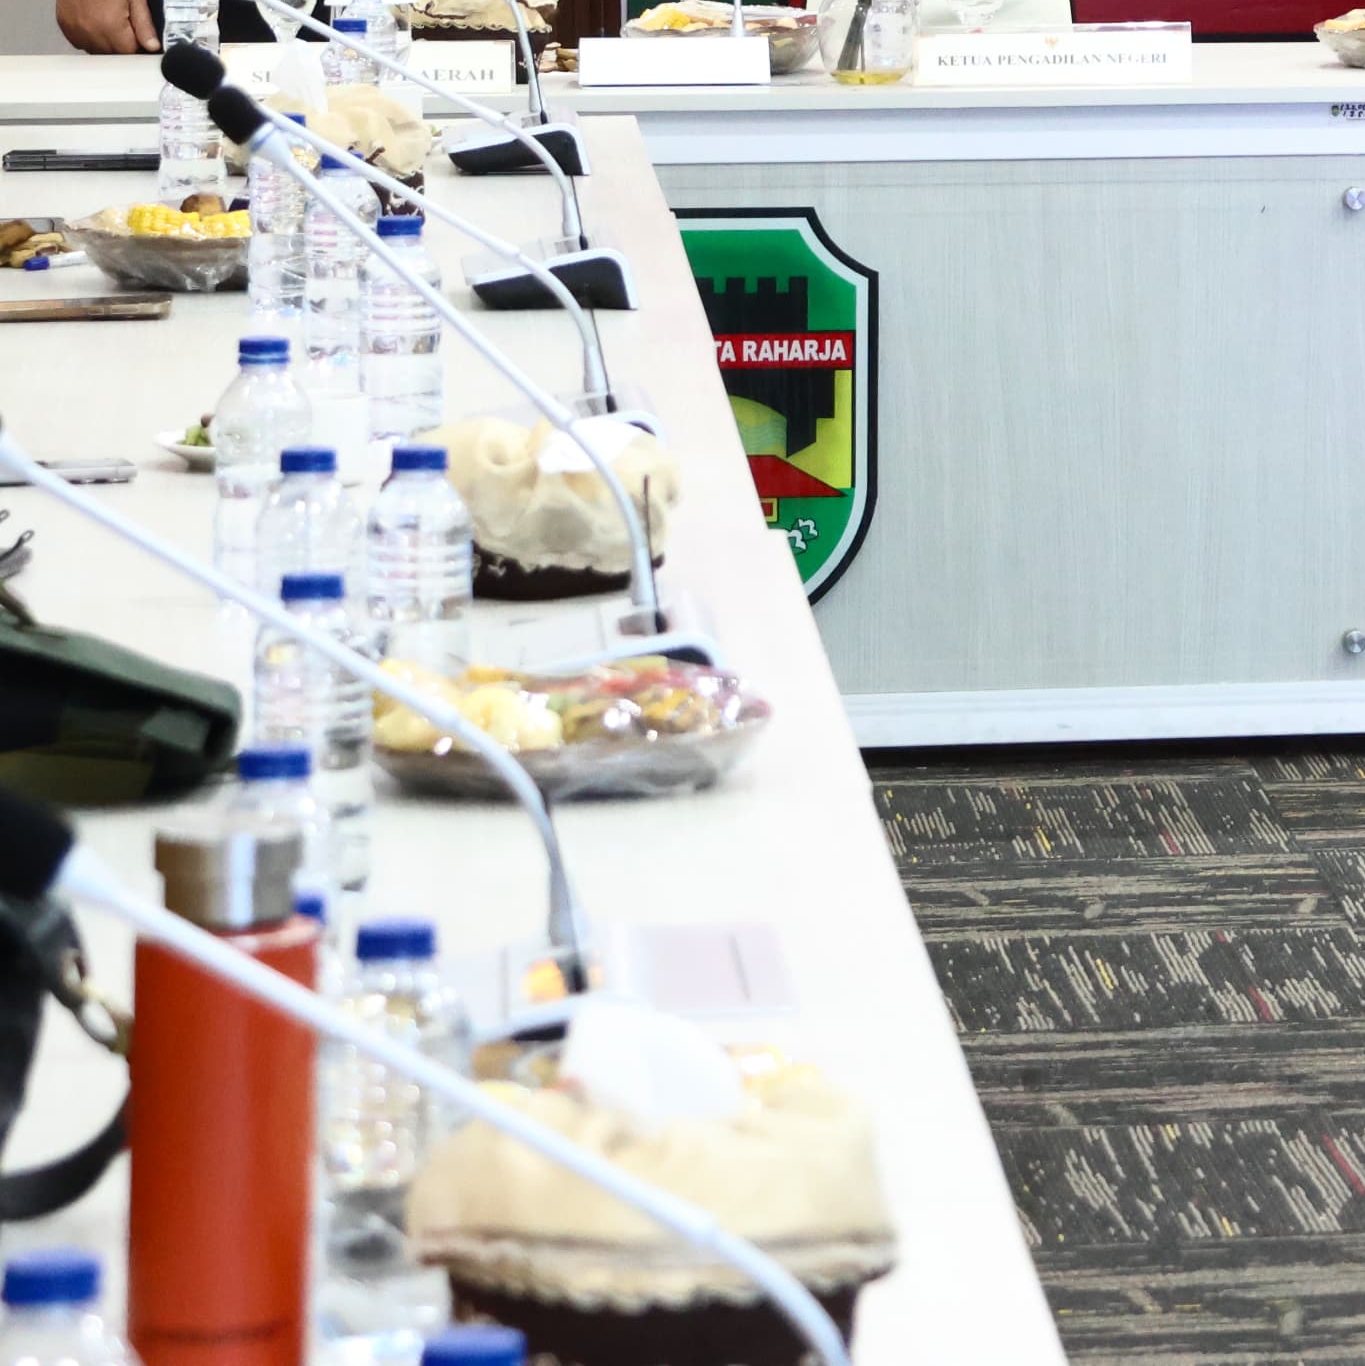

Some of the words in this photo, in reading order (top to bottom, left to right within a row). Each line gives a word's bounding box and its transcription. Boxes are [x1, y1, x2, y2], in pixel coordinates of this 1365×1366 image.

[937, 55, 992, 66] KETUA
[998, 54, 1102, 65] PENGADILAN
[1107, 53, 1168, 64] NEGERI
[742, 339, 847, 362] RAHARJA
